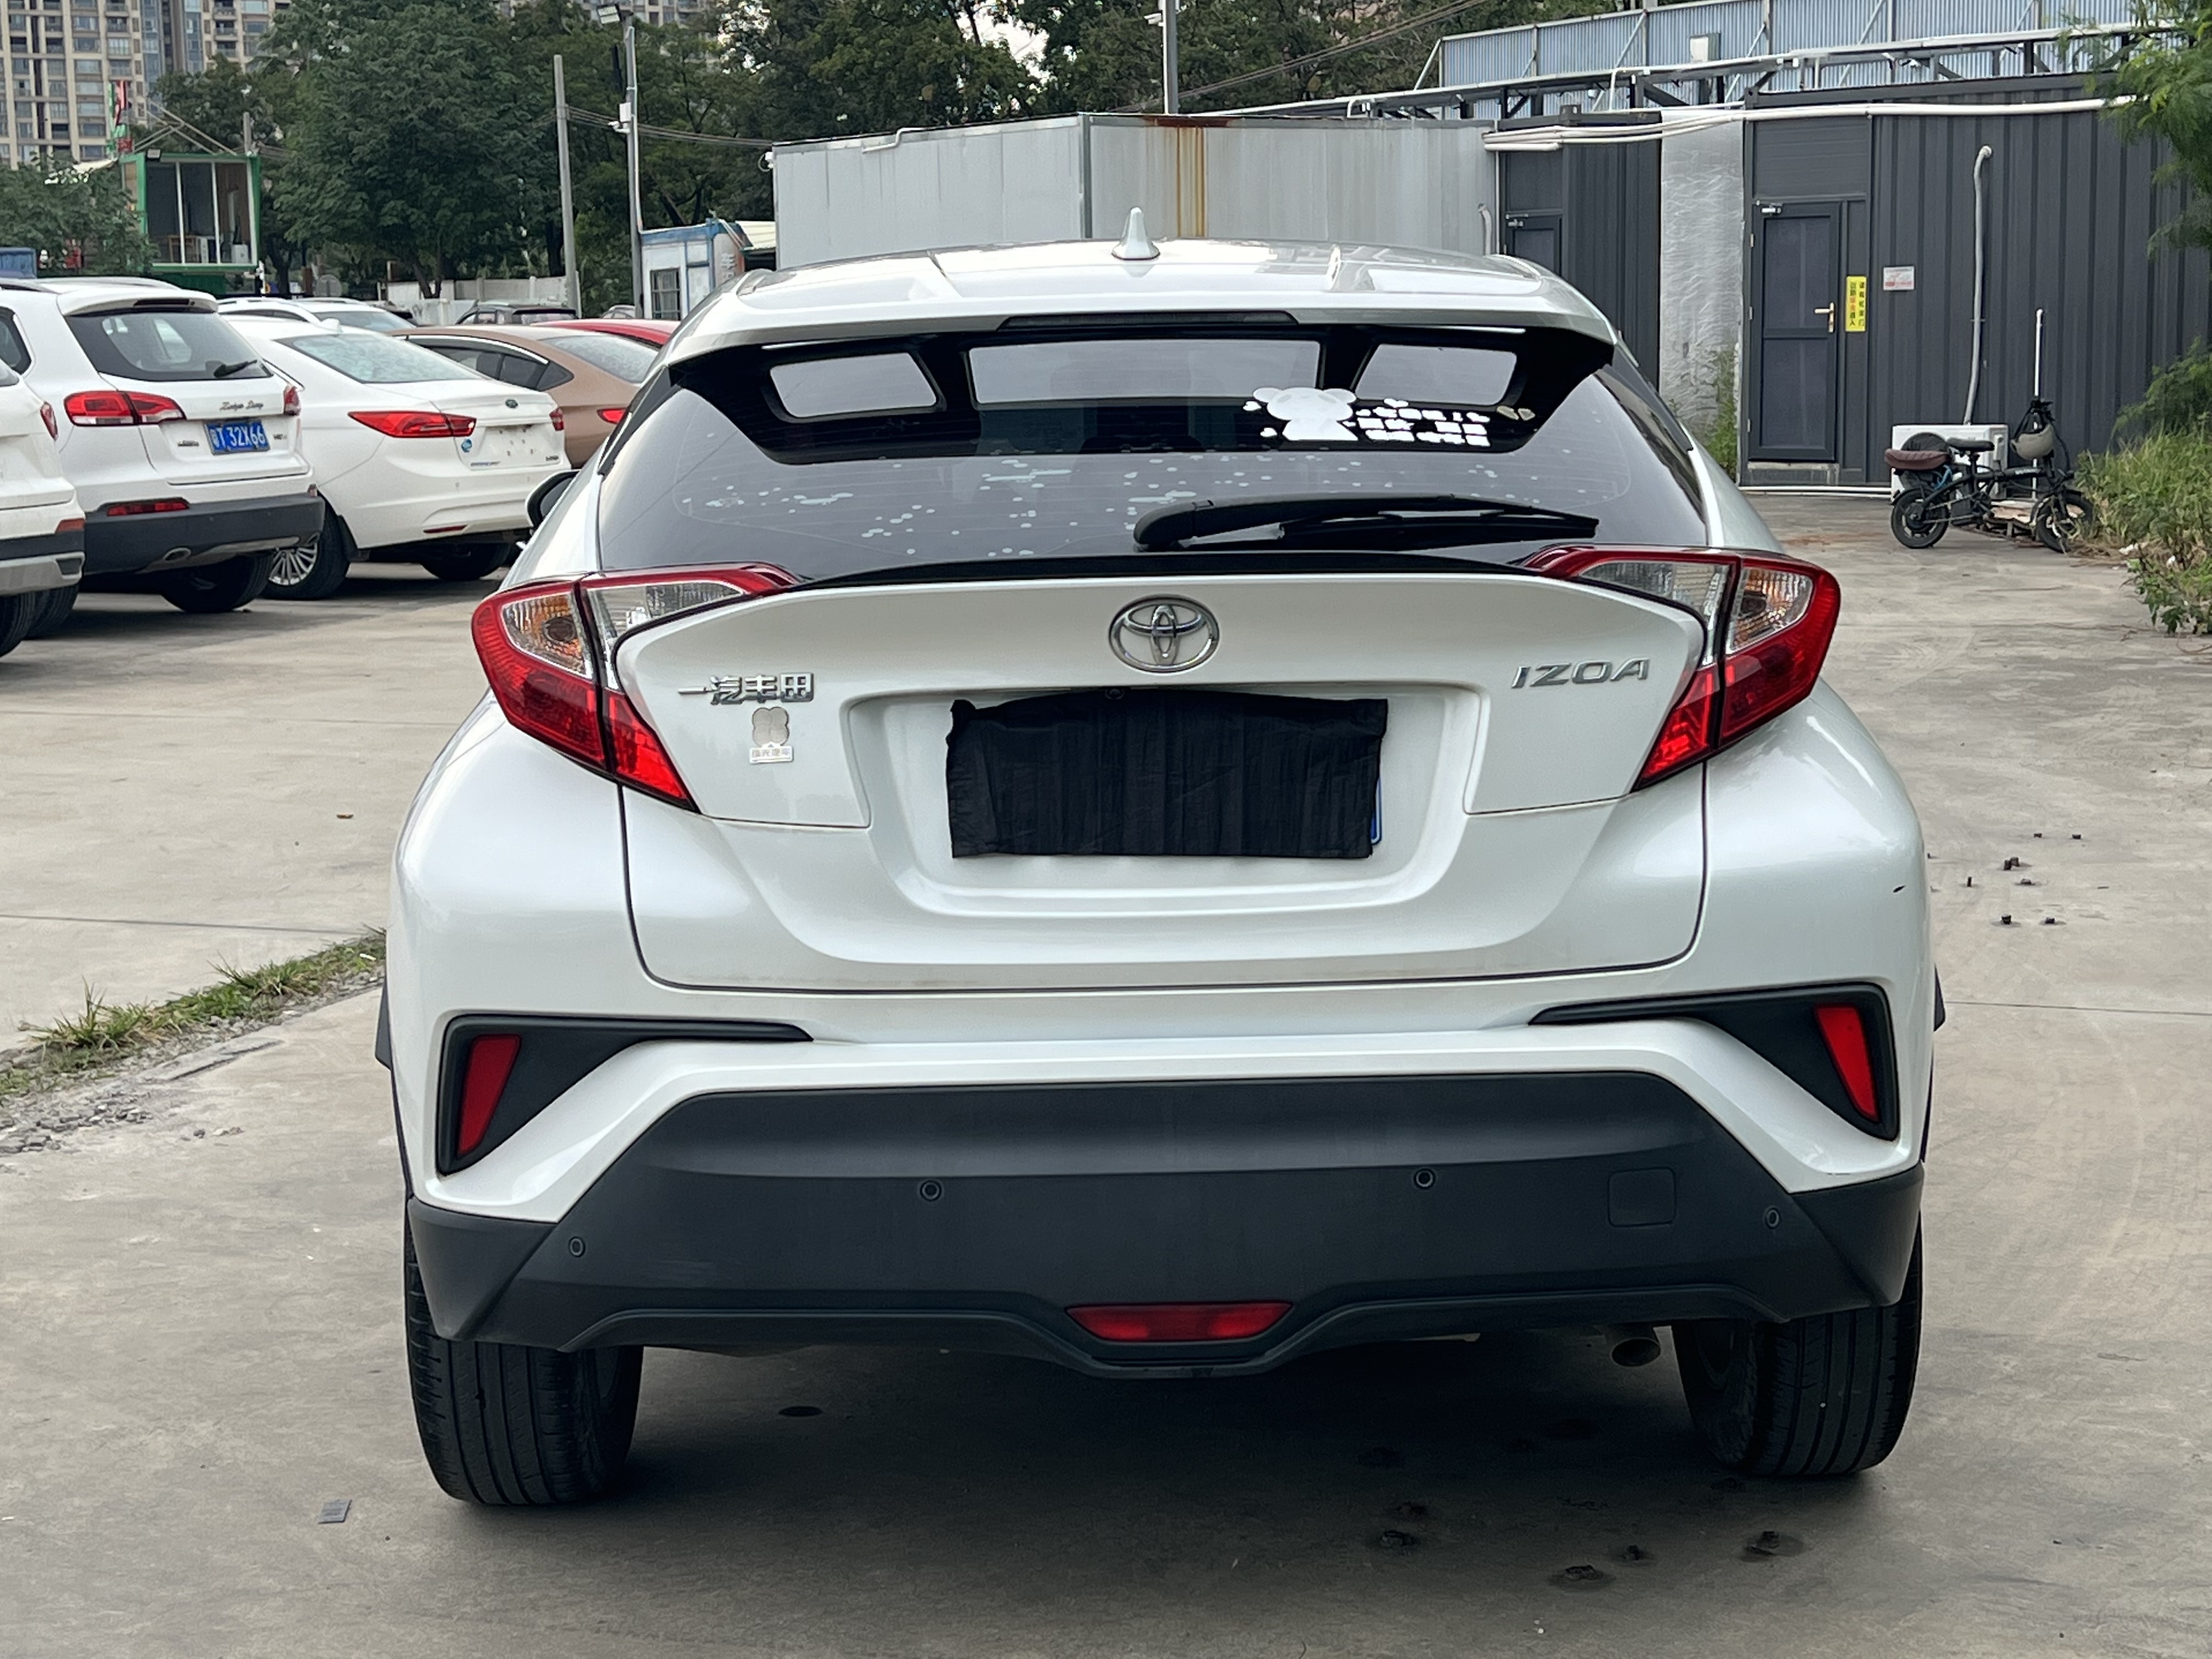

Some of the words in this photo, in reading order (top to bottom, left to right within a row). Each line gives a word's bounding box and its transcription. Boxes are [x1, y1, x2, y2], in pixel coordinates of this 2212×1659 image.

[678, 672, 815, 705] 一汽丰田
[1511, 657, 1649, 689] IZOA
